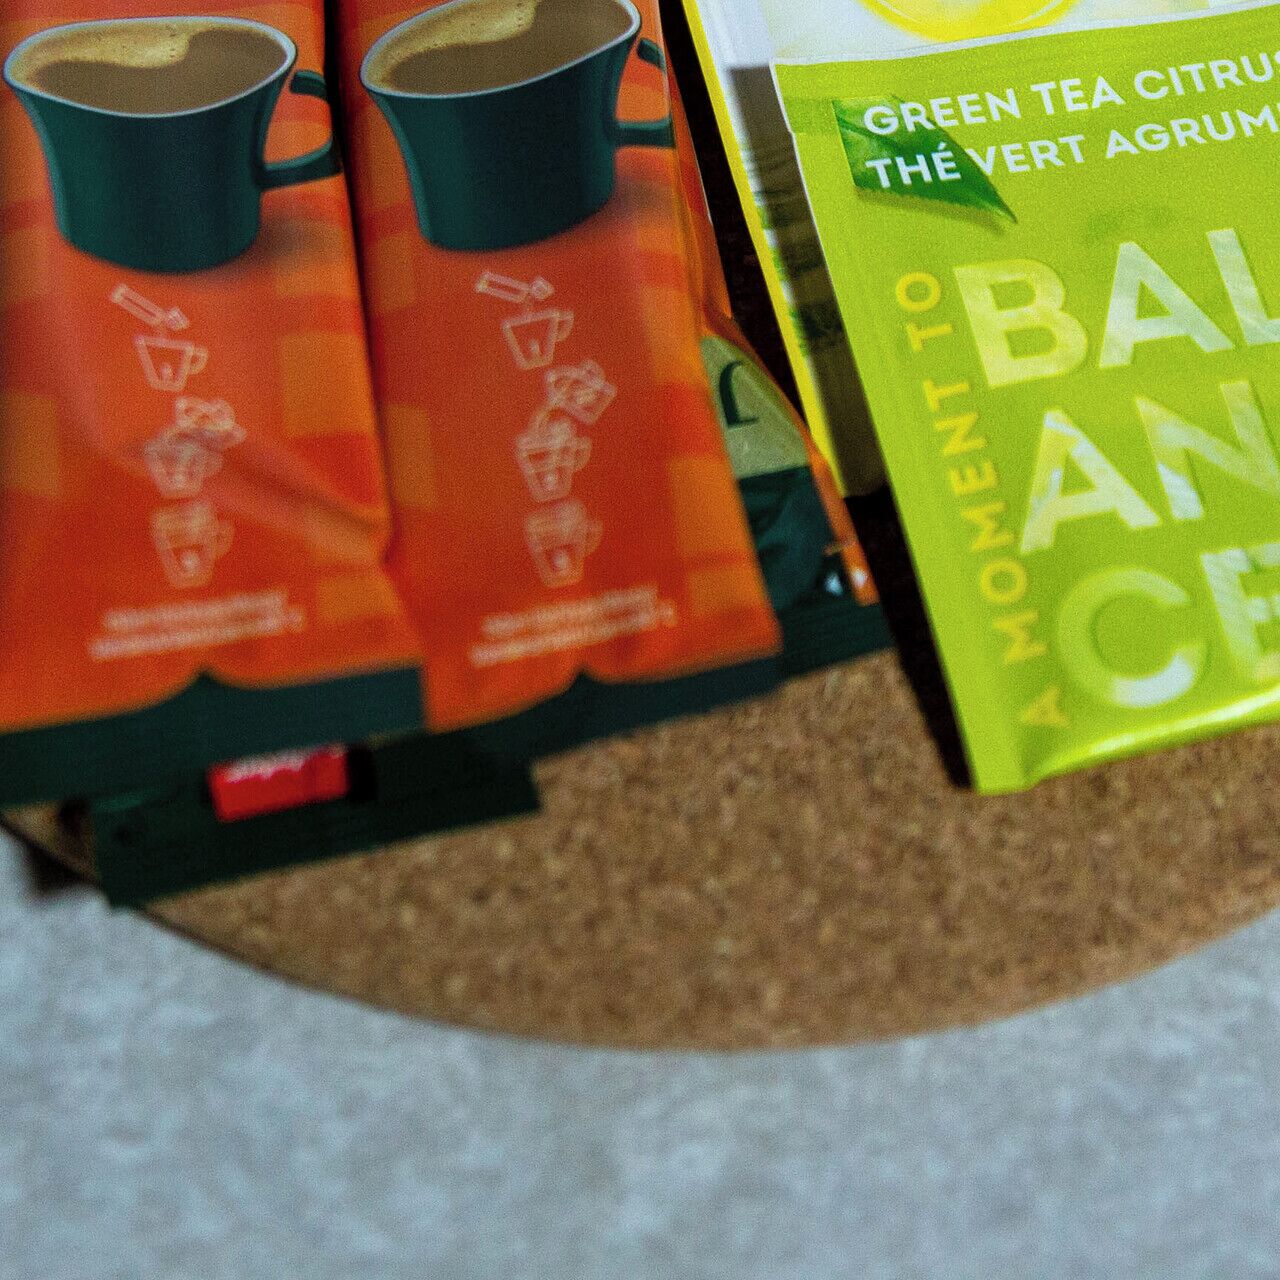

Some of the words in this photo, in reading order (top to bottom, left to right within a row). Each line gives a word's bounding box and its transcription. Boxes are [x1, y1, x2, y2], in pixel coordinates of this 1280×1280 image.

[863, 87, 1022, 136] GREEN
[1031, 75, 1124, 115] TEA
[866, 141, 962, 189] THÉ
[967, 134, 1086, 176] VERT
[895, 270, 953, 352] TO
[923, 379, 1049, 666] MOMENT
